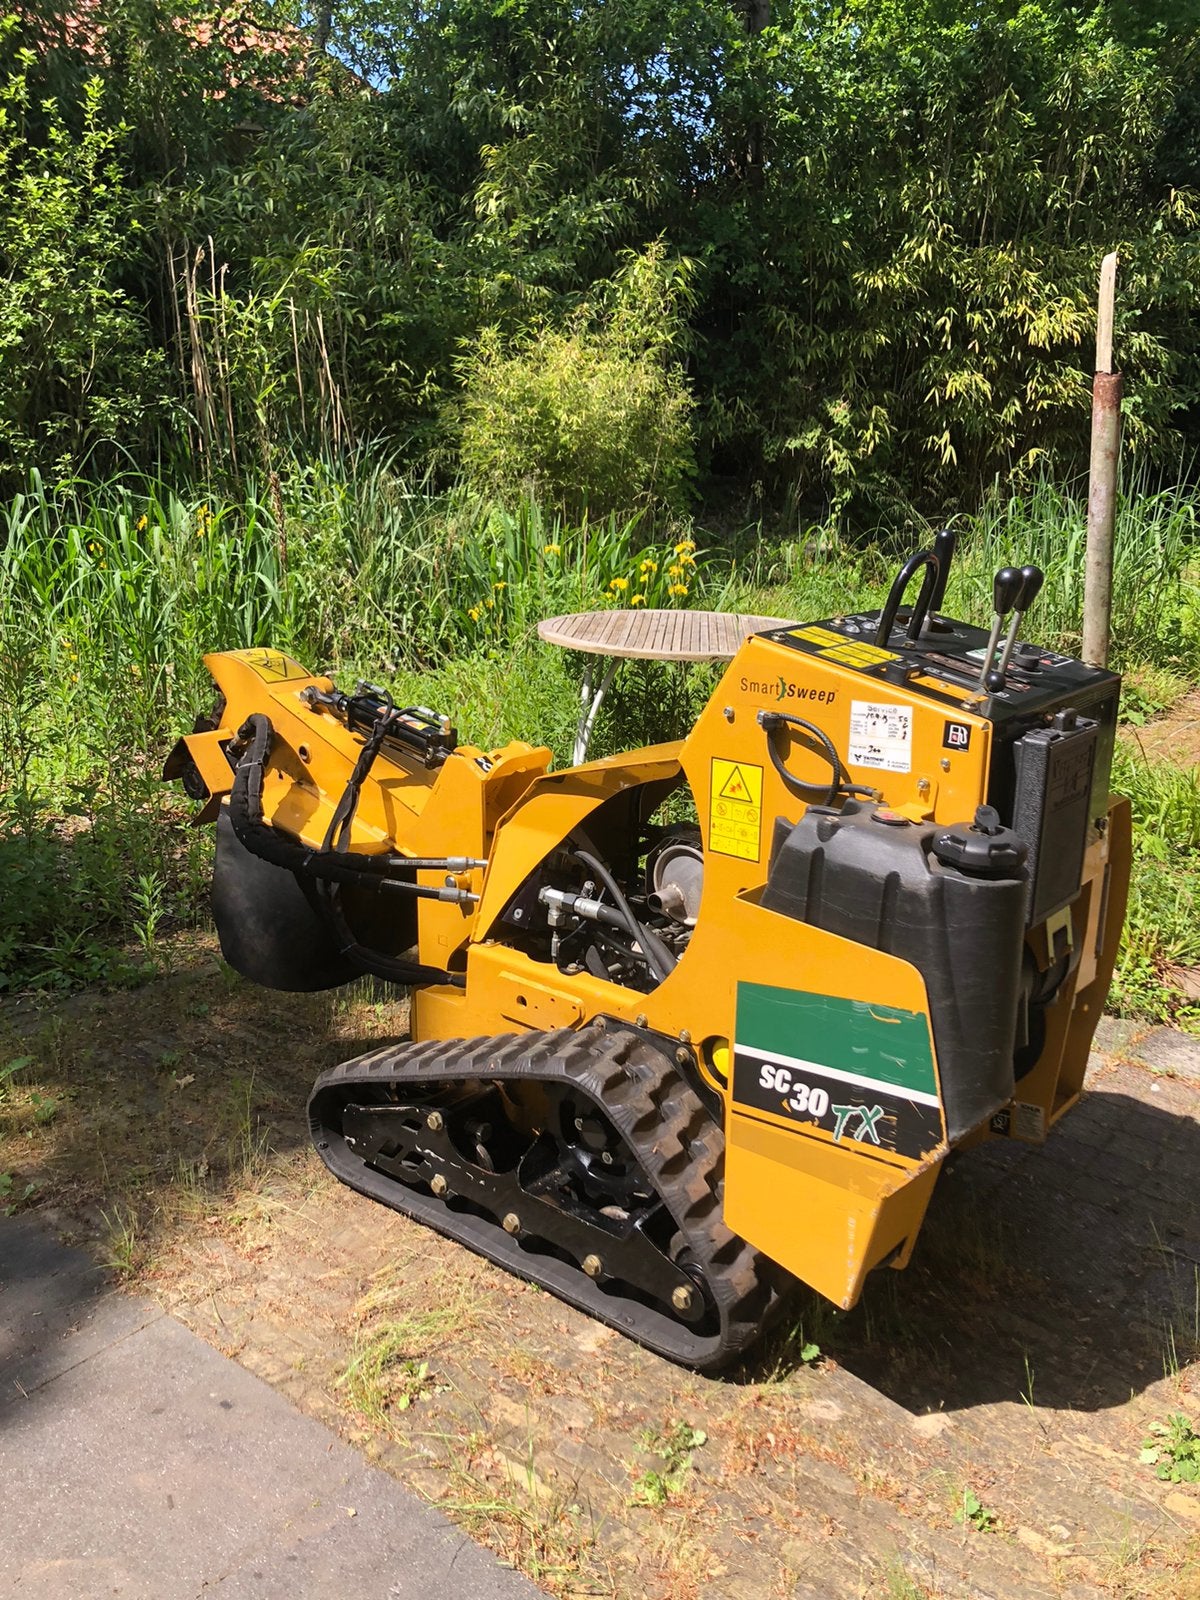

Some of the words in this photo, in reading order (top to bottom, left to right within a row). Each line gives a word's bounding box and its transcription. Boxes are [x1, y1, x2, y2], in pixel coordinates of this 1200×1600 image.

[740, 677, 780, 696] Smart
[786, 683, 836, 705] Sweep
[758, 1064, 829, 1117] SC30
[831, 1104, 885, 1145] TX
